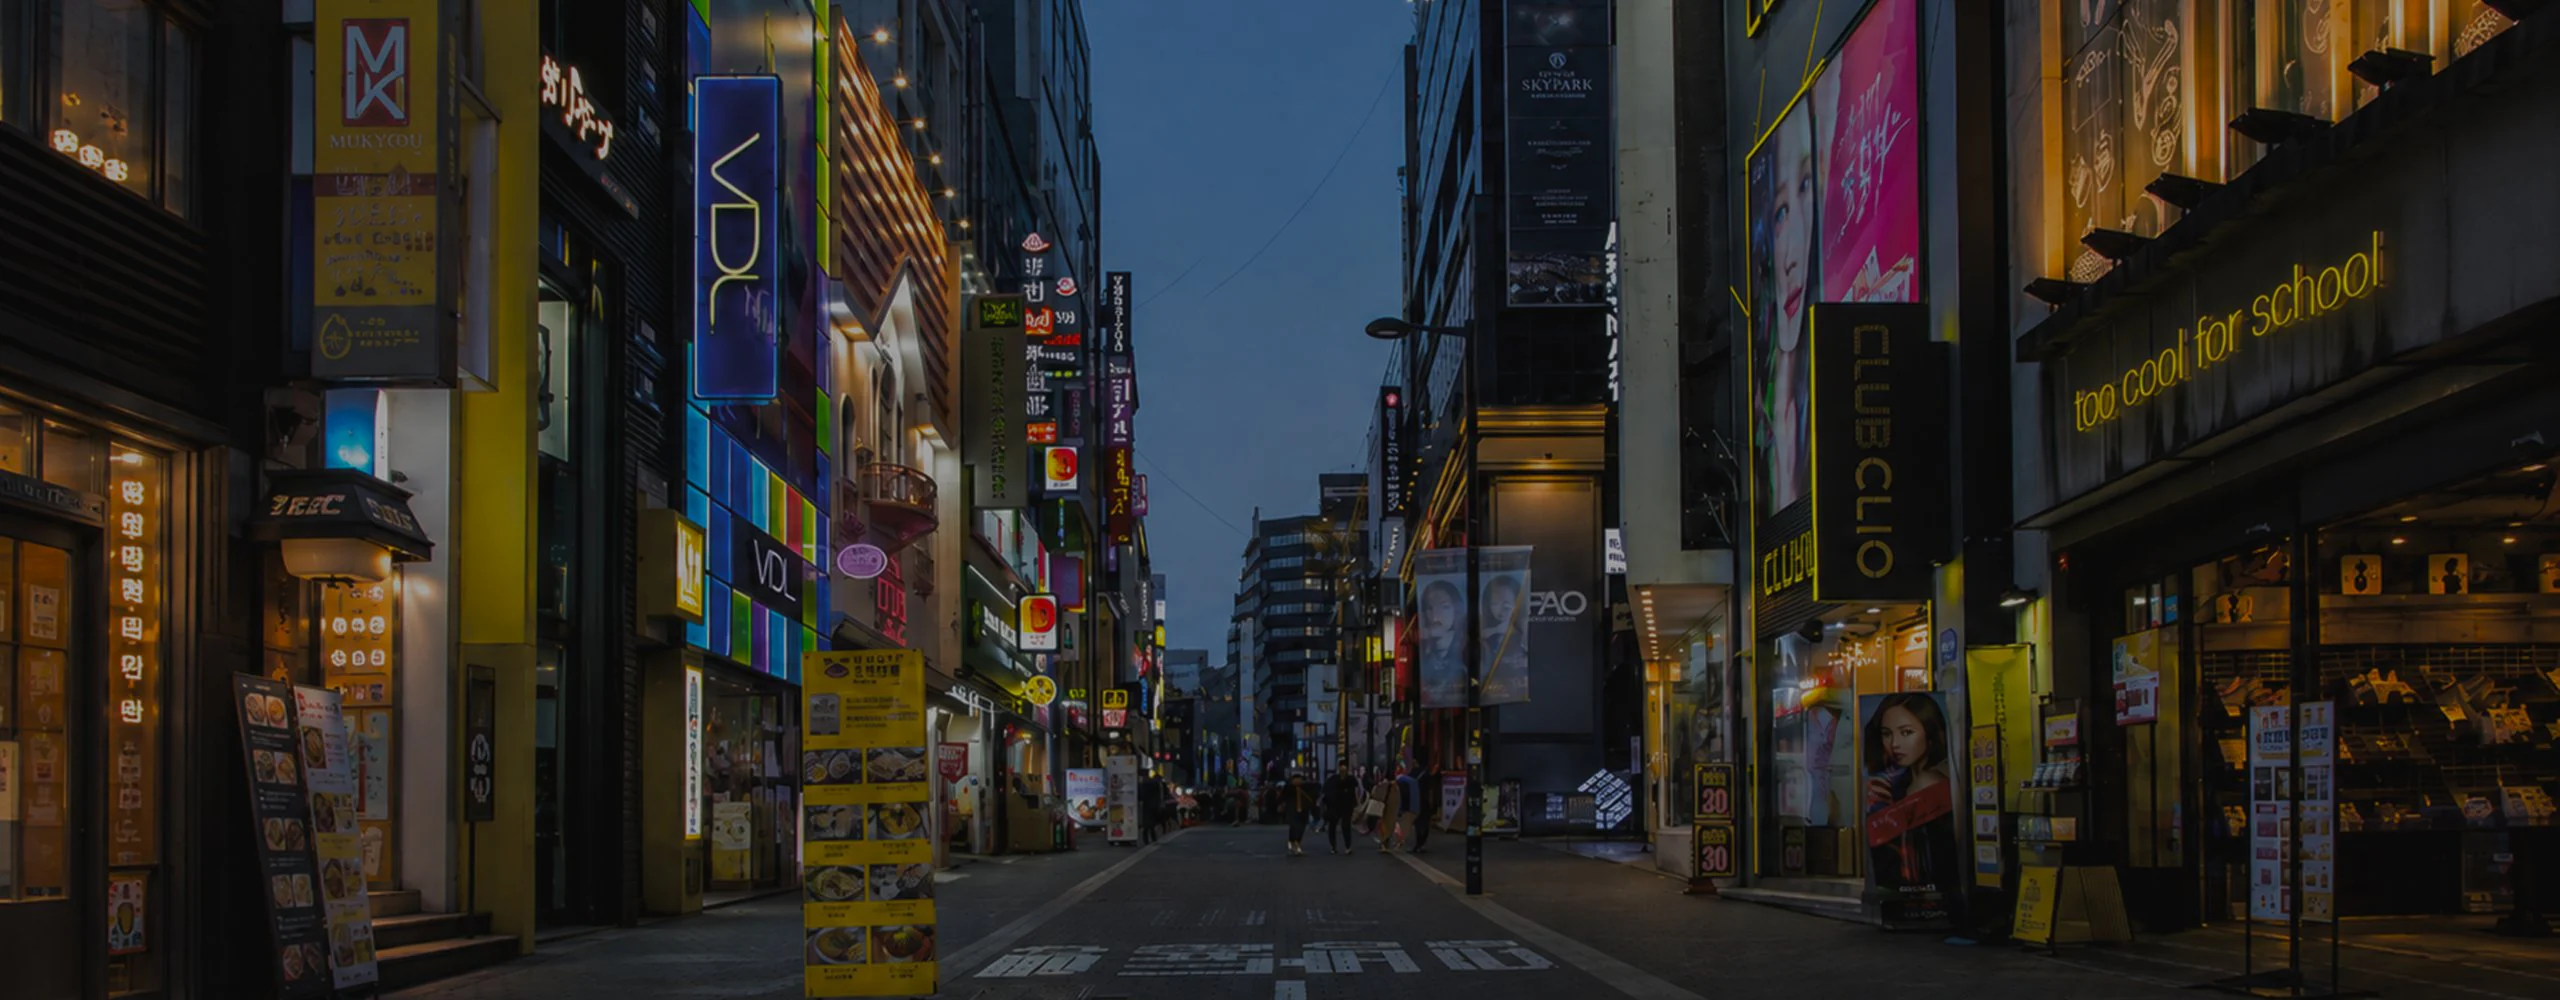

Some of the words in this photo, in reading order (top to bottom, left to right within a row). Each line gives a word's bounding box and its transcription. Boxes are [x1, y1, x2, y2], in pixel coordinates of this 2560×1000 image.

[1522, 79, 1593, 92] SKYPARK
[709, 131, 760, 334] VDL
[2074, 383, 2116, 432] too
[2122, 327, 2185, 407] cool
[2193, 309, 2243, 368] for
[2252, 230, 2380, 337] school
[753, 539, 797, 603] VDL
[1701, 844, 1729, 872] 30
